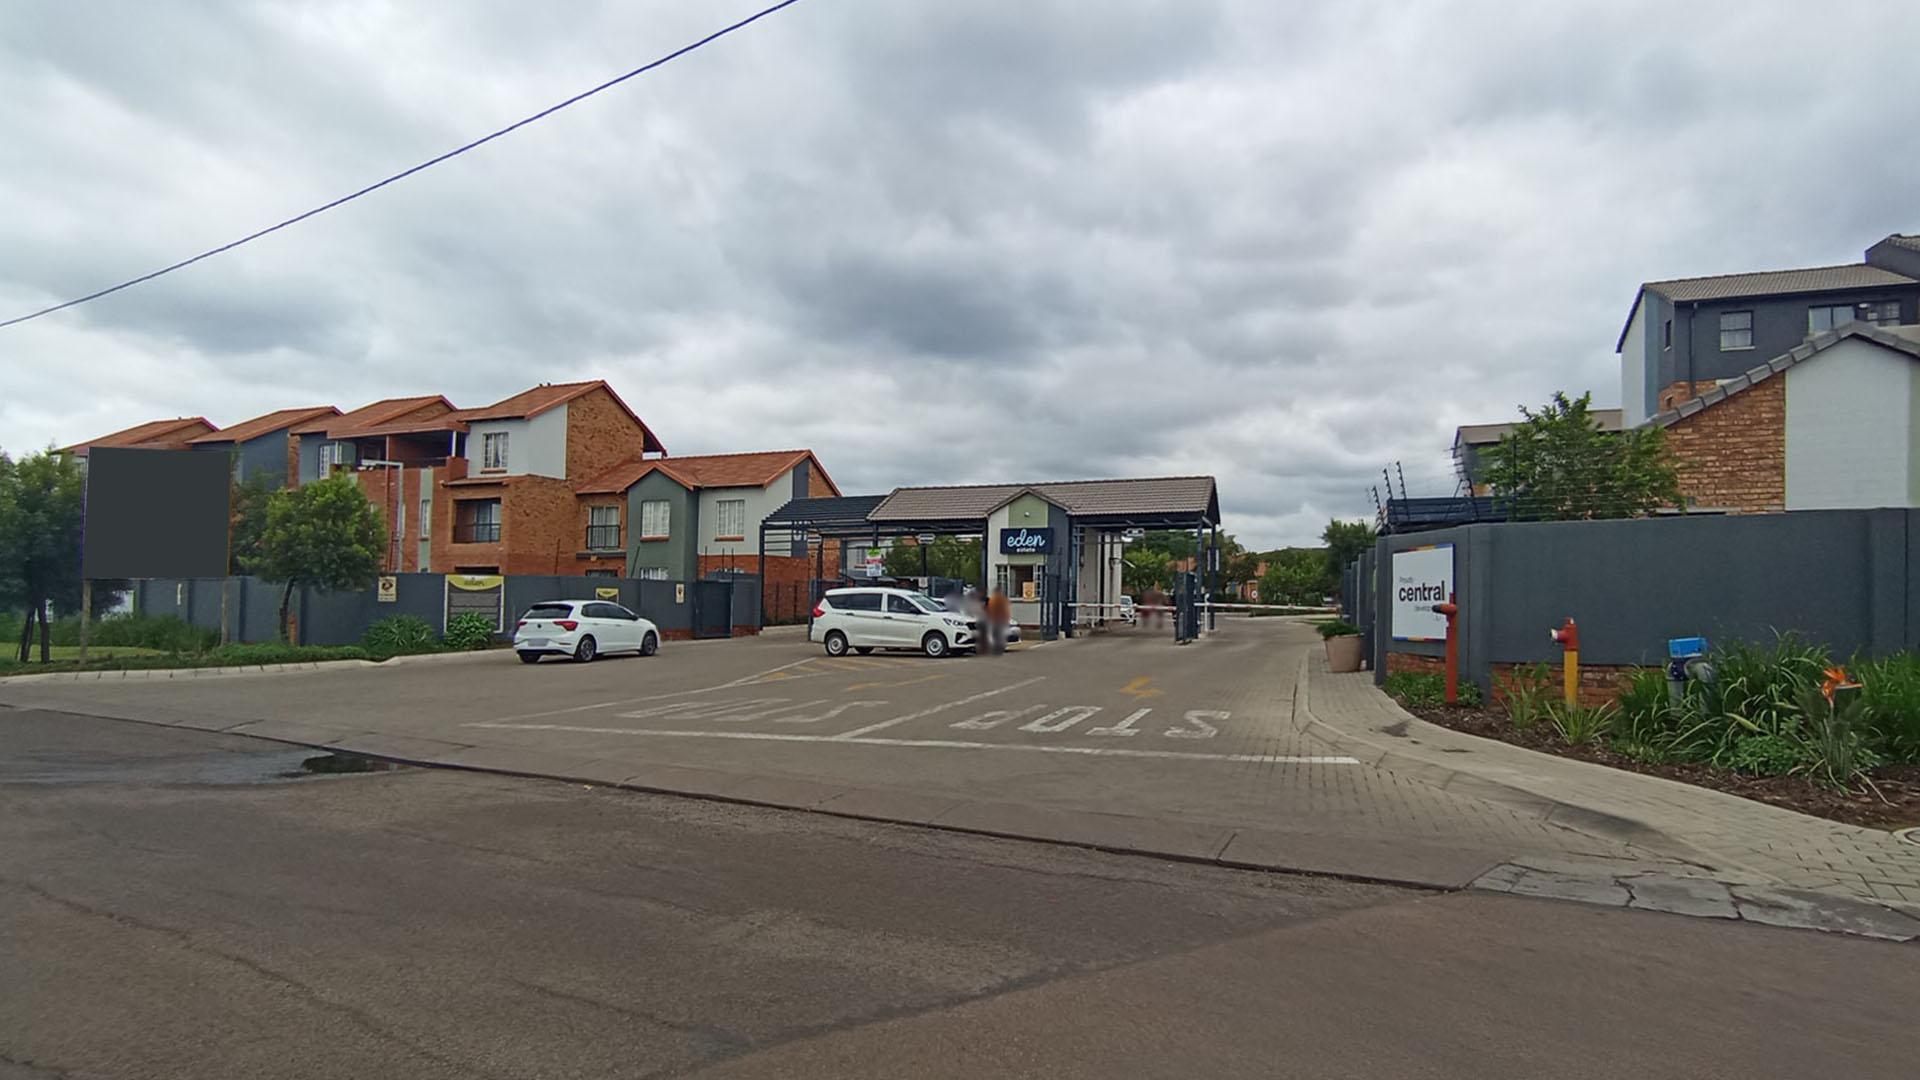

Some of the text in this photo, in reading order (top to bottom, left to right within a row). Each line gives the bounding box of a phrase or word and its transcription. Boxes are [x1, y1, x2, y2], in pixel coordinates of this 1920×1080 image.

[1007, 529, 1046, 547] eden
[1398, 580, 1445, 602] central
[949, 704, 1232, 738] STOP
